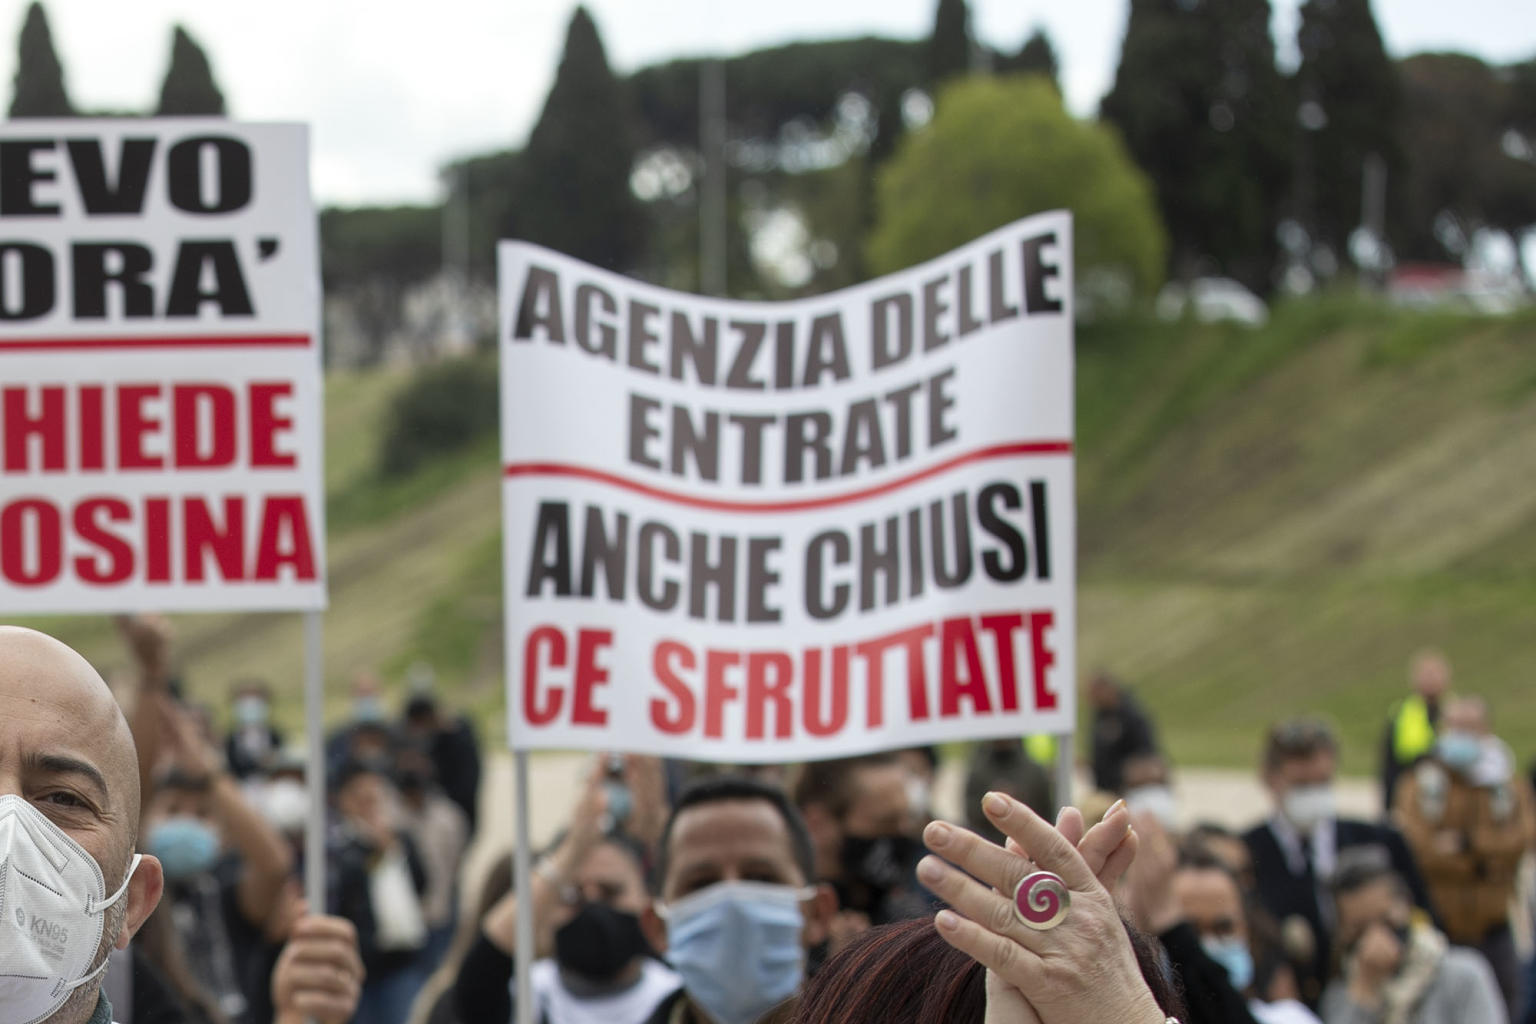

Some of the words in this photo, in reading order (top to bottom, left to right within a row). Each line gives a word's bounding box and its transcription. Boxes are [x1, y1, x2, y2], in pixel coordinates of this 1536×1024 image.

[514, 264, 852, 390] AGENZIA
[871, 232, 1064, 376] DELLE
[626, 366, 959, 486] ENTRATE
[525, 499, 783, 624] ANCHE
[804, 479, 1053, 621] CHIUSI
[523, 625, 614, 727] CE
[649, 610, 1058, 741] SFRUTTATE
